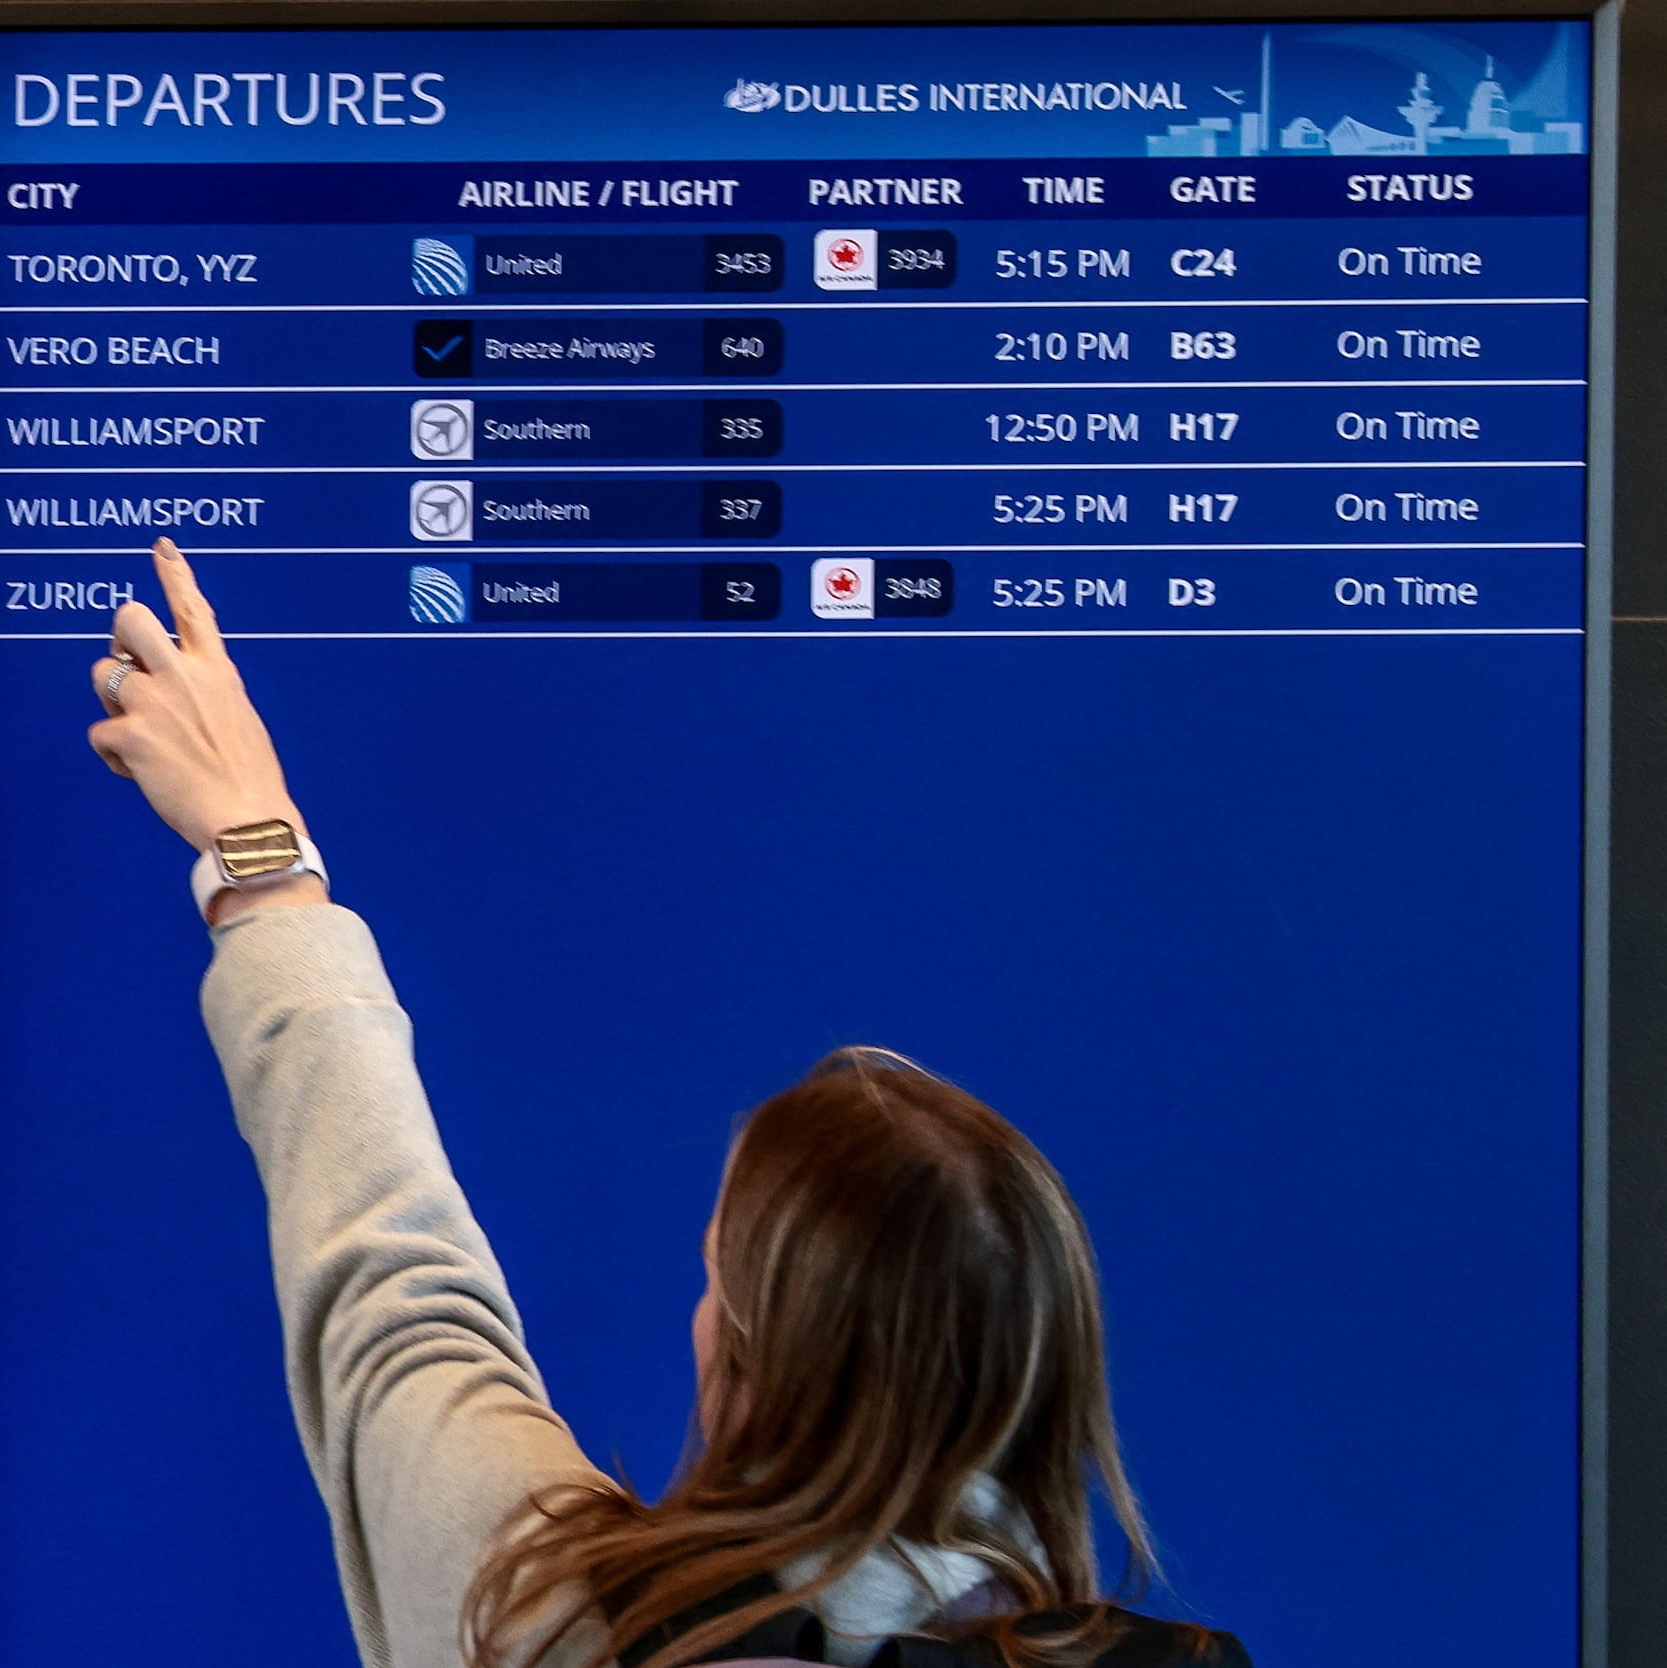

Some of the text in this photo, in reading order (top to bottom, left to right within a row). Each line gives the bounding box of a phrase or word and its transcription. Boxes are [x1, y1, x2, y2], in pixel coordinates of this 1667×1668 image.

[15, 72, 446, 126] DEPARTURES
[785, 82, 1187, 112] DULLES INTERNATIONAL
[8, 183, 80, 209] CITY
[458, 180, 739, 207] AIRLINE / FLIGHT
[809, 178, 964, 205] PARTNER
[1022, 177, 1104, 204] TIME
[1170, 176, 1256, 202] GATE
[1347, 174, 1473, 201] STATUS
[7, 254, 258, 286] TORONTO, YYZ
[486, 253, 562, 275] United
[996, 249, 1130, 278] 5:15 PM
[1171, 248, 1237, 277] C24
[1338, 246, 1482, 275] On Time
[8, 337, 219, 365] VERO BEACH
[486, 337, 655, 364] Breeze Airways
[995, 332, 1129, 361] 2:10 PM
[1171, 331, 1236, 359] B63
[1337, 330, 1481, 358] On Time
[6, 417, 265, 445] WILLIAMSPORT
[484, 418, 590, 440] Southern
[986, 413, 1138, 442] 12:50 PM
[1170, 413, 1239, 441] H17
[1336, 411, 1480, 440] On Time
[6, 498, 265, 526] WILLIAMSPORT
[483, 499, 590, 521] Southern
[994, 495, 1127, 523] 5:25 PM
[1169, 494, 1238, 522] H17
[1336, 492, 1479, 521] On Time
[7, 583, 137, 615] ZURICH
[483, 581, 559, 603] United
[993, 579, 1126, 607] 5:25 PM
[1169, 578, 1216, 606] D3
[1335, 577, 1478, 605] On Time
